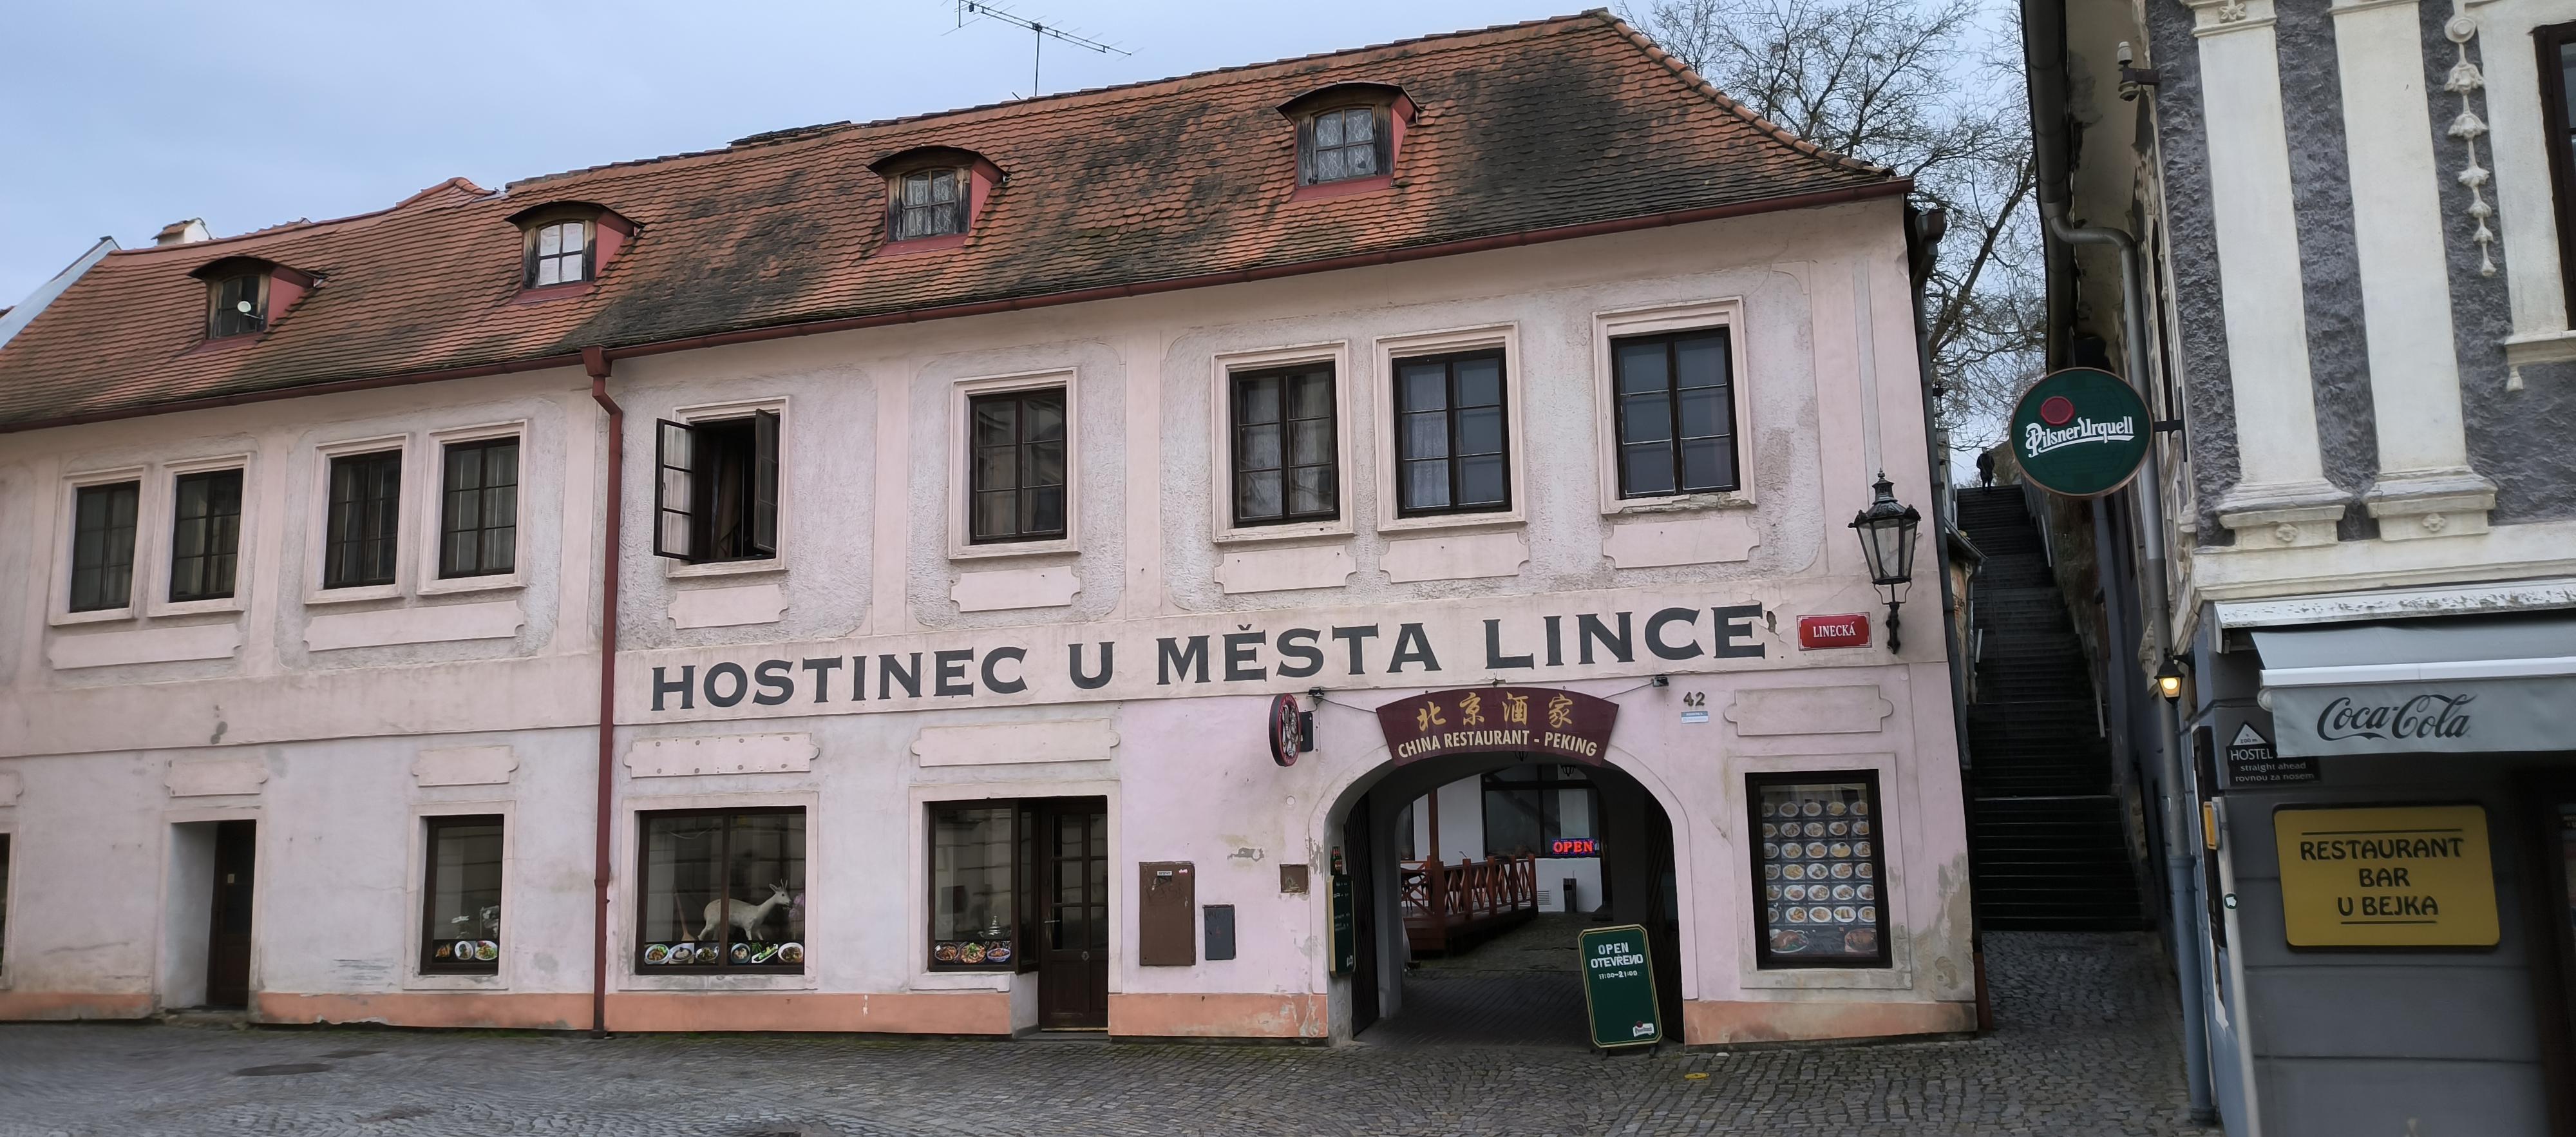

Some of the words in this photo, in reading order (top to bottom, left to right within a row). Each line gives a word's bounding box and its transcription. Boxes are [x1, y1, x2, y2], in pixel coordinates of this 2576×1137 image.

[2025, 423, 2080, 458] Pilsner
[2078, 416, 2134, 444] Urquell
[1813, 621, 1857, 638] LINECKÁ
[650, 646, 1028, 711] HOSTINEC
[1068, 641, 1115, 689] U
[1156, 622, 1443, 685] MĚSTA
[1482, 601, 1766, 670] LINCE
[1683, 691, 1705, 707] 42
[1416, 691, 1573, 732] 北京酒家
[2316, 694, 2478, 741] Coca-Cola
[1397, 734, 1441, 758] CHINA
[1444, 730, 1530, 748] RESTAURANT
[1544, 731, 1598, 757] PEKING
[2231, 749, 2273, 761] HOSTEL
[2240, 763, 2276, 772] straight
[2278, 762, 2307, 770] ahead
[1553, 841, 1593, 853] OPEN
[2300, 838, 2464, 861] RESTAURANT
[2358, 867, 2410, 888] BAR
[2337, 897, 2354, 916] U
[2362, 895, 2438, 916] BEJKA
[1598, 942, 1629, 955] OPEN
